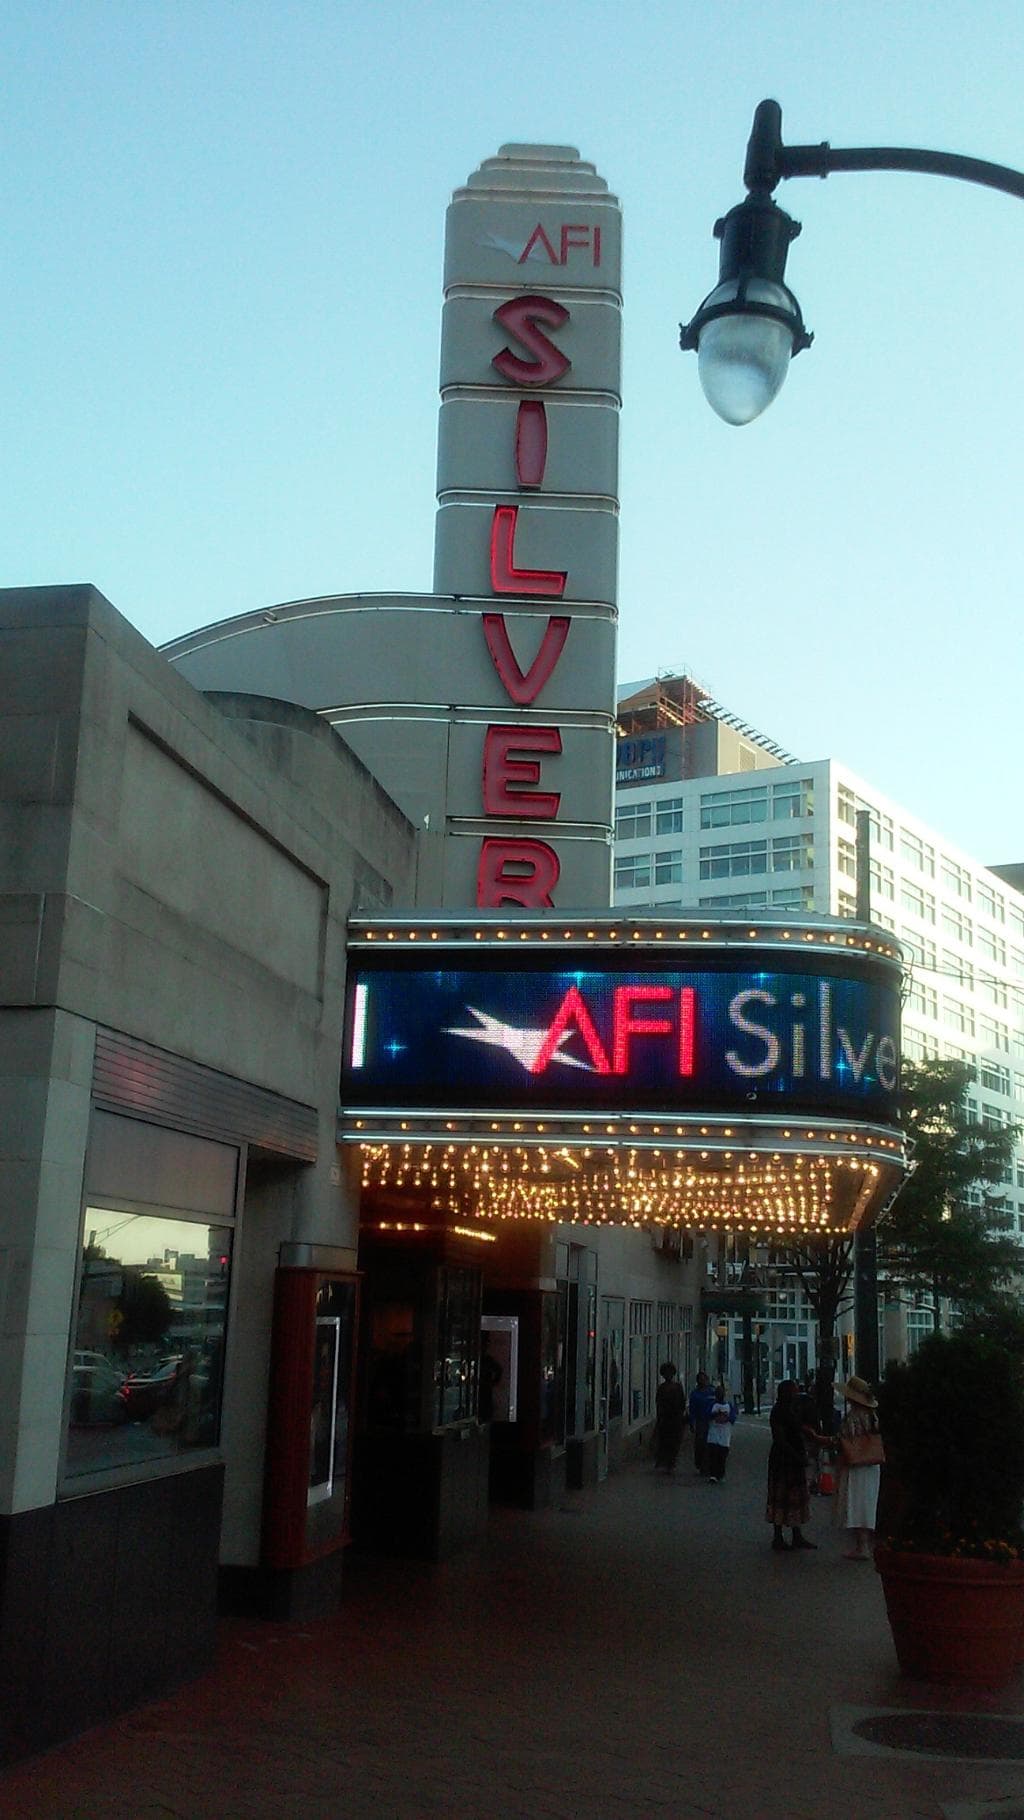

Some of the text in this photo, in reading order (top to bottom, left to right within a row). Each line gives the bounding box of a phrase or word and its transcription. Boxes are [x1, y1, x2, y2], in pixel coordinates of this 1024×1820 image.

[518, 222, 601, 267] AFI
[476, 295, 572, 908] SILVER
[526, 980, 898, 1092] AFI Silve
